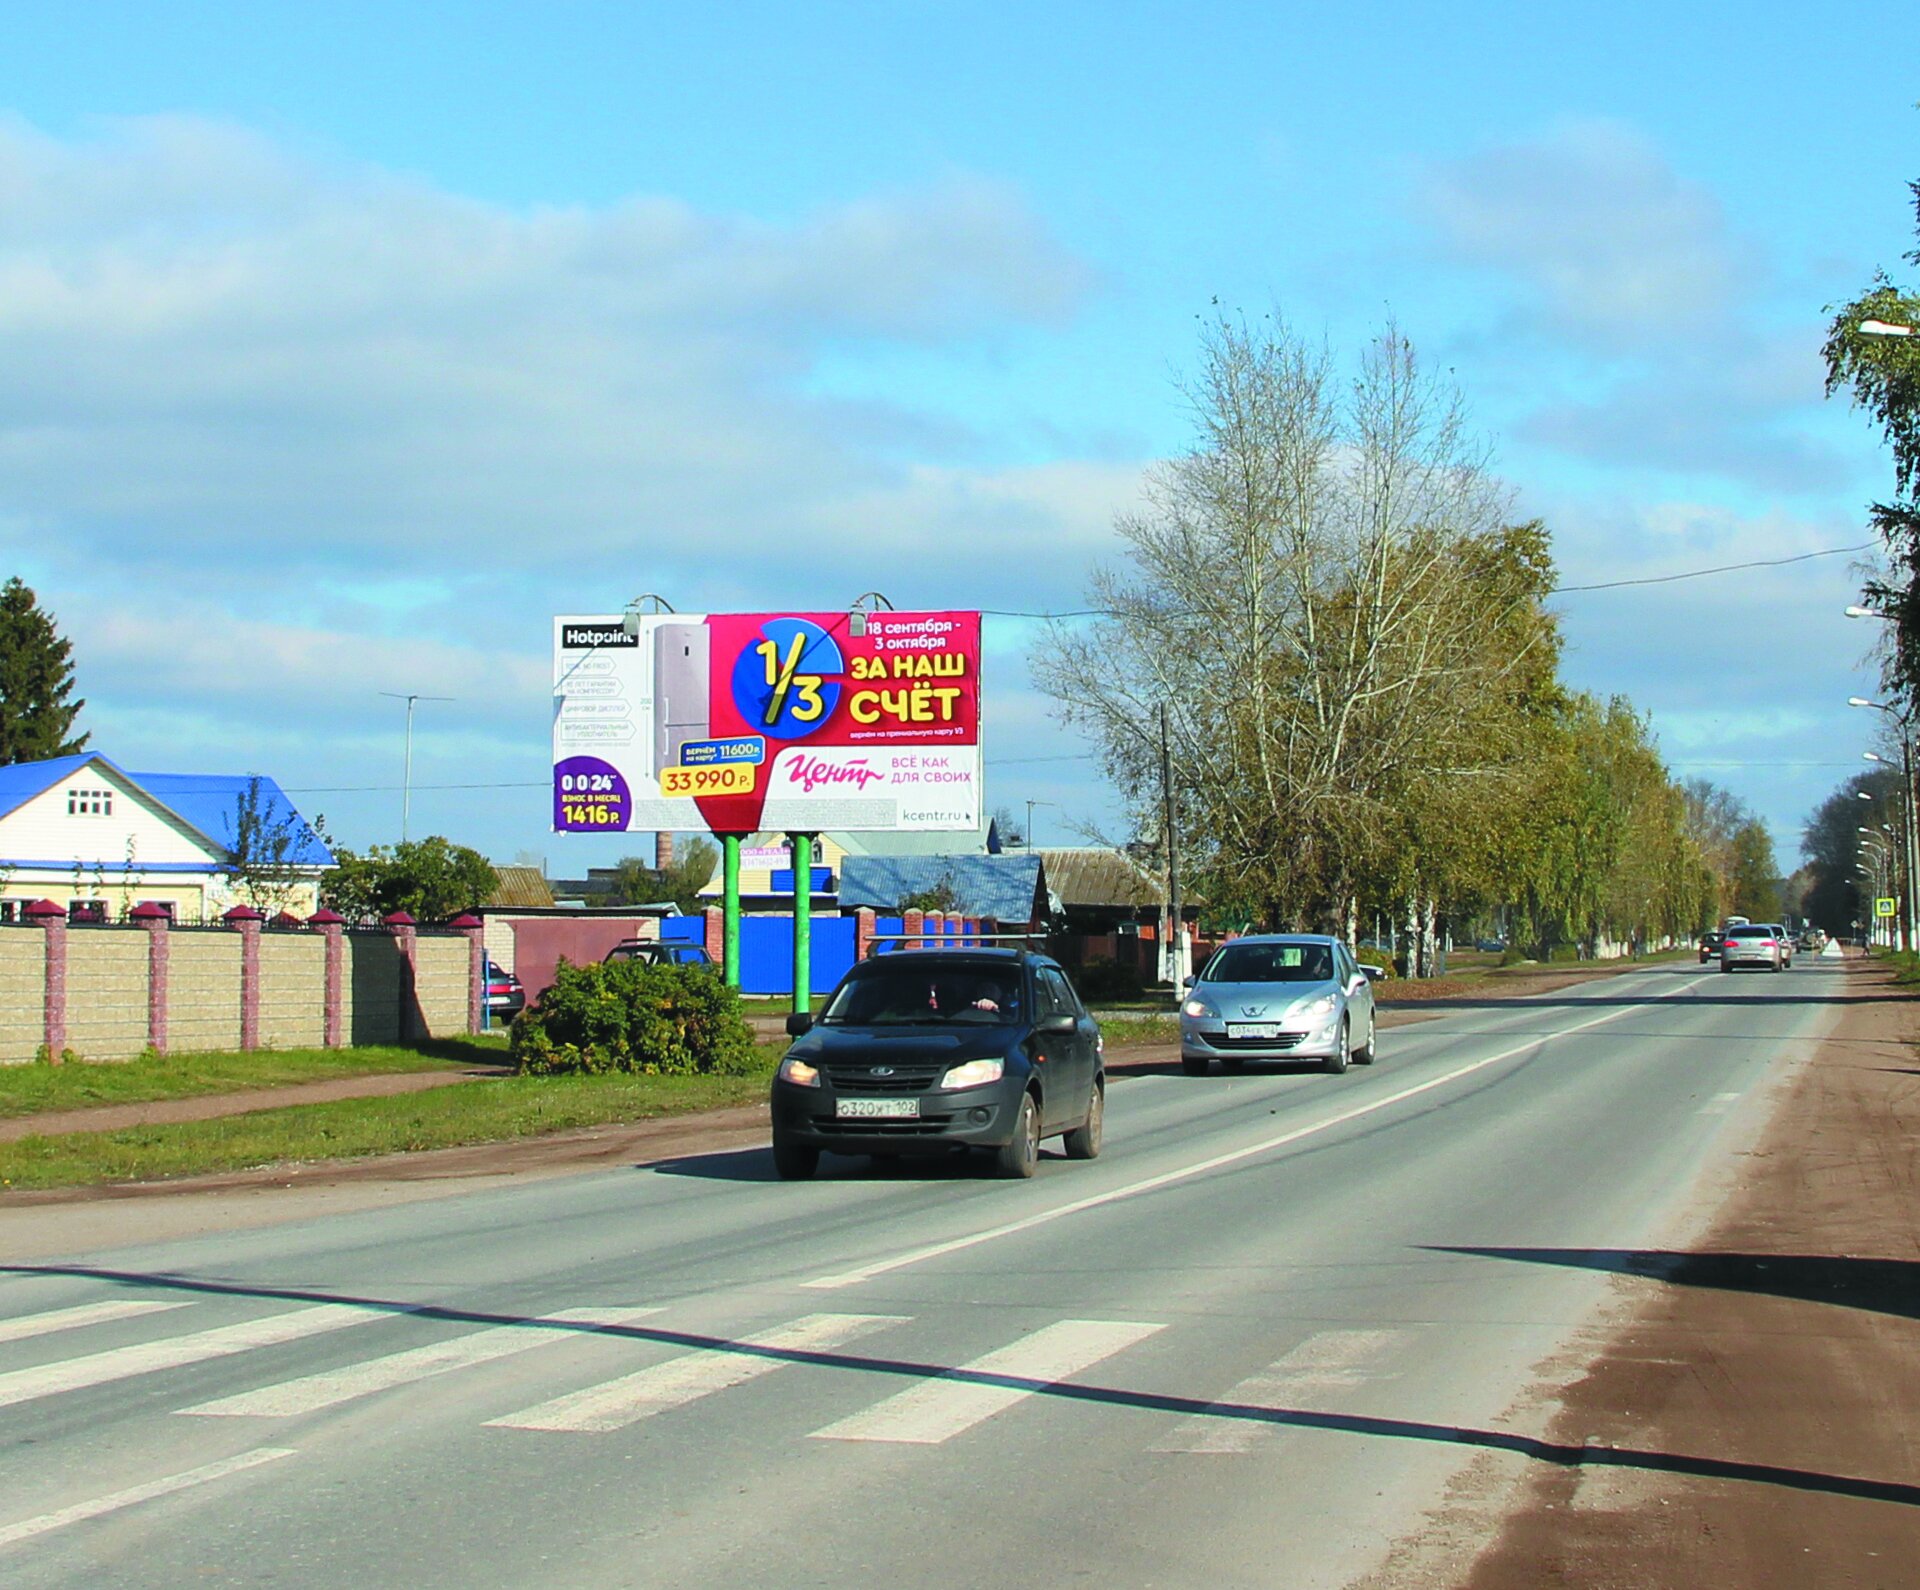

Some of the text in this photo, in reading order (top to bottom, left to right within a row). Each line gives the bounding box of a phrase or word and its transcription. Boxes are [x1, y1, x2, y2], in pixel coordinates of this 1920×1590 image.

[867, 622, 882, 635] 18
[885, 618, 952, 634] сентября
[874, 634, 946, 650] 3 октября
[851, 653, 965, 679] ЗА НАШ
[849, 681, 961, 723] СЧЁТ
[891, 756, 949, 768] ВСЁ КАК
[784, 754, 885, 792] Центр
[891, 771, 972, 784] ДЛЯ СВОИХ
[903, 810, 961, 821] kcentr.ru
